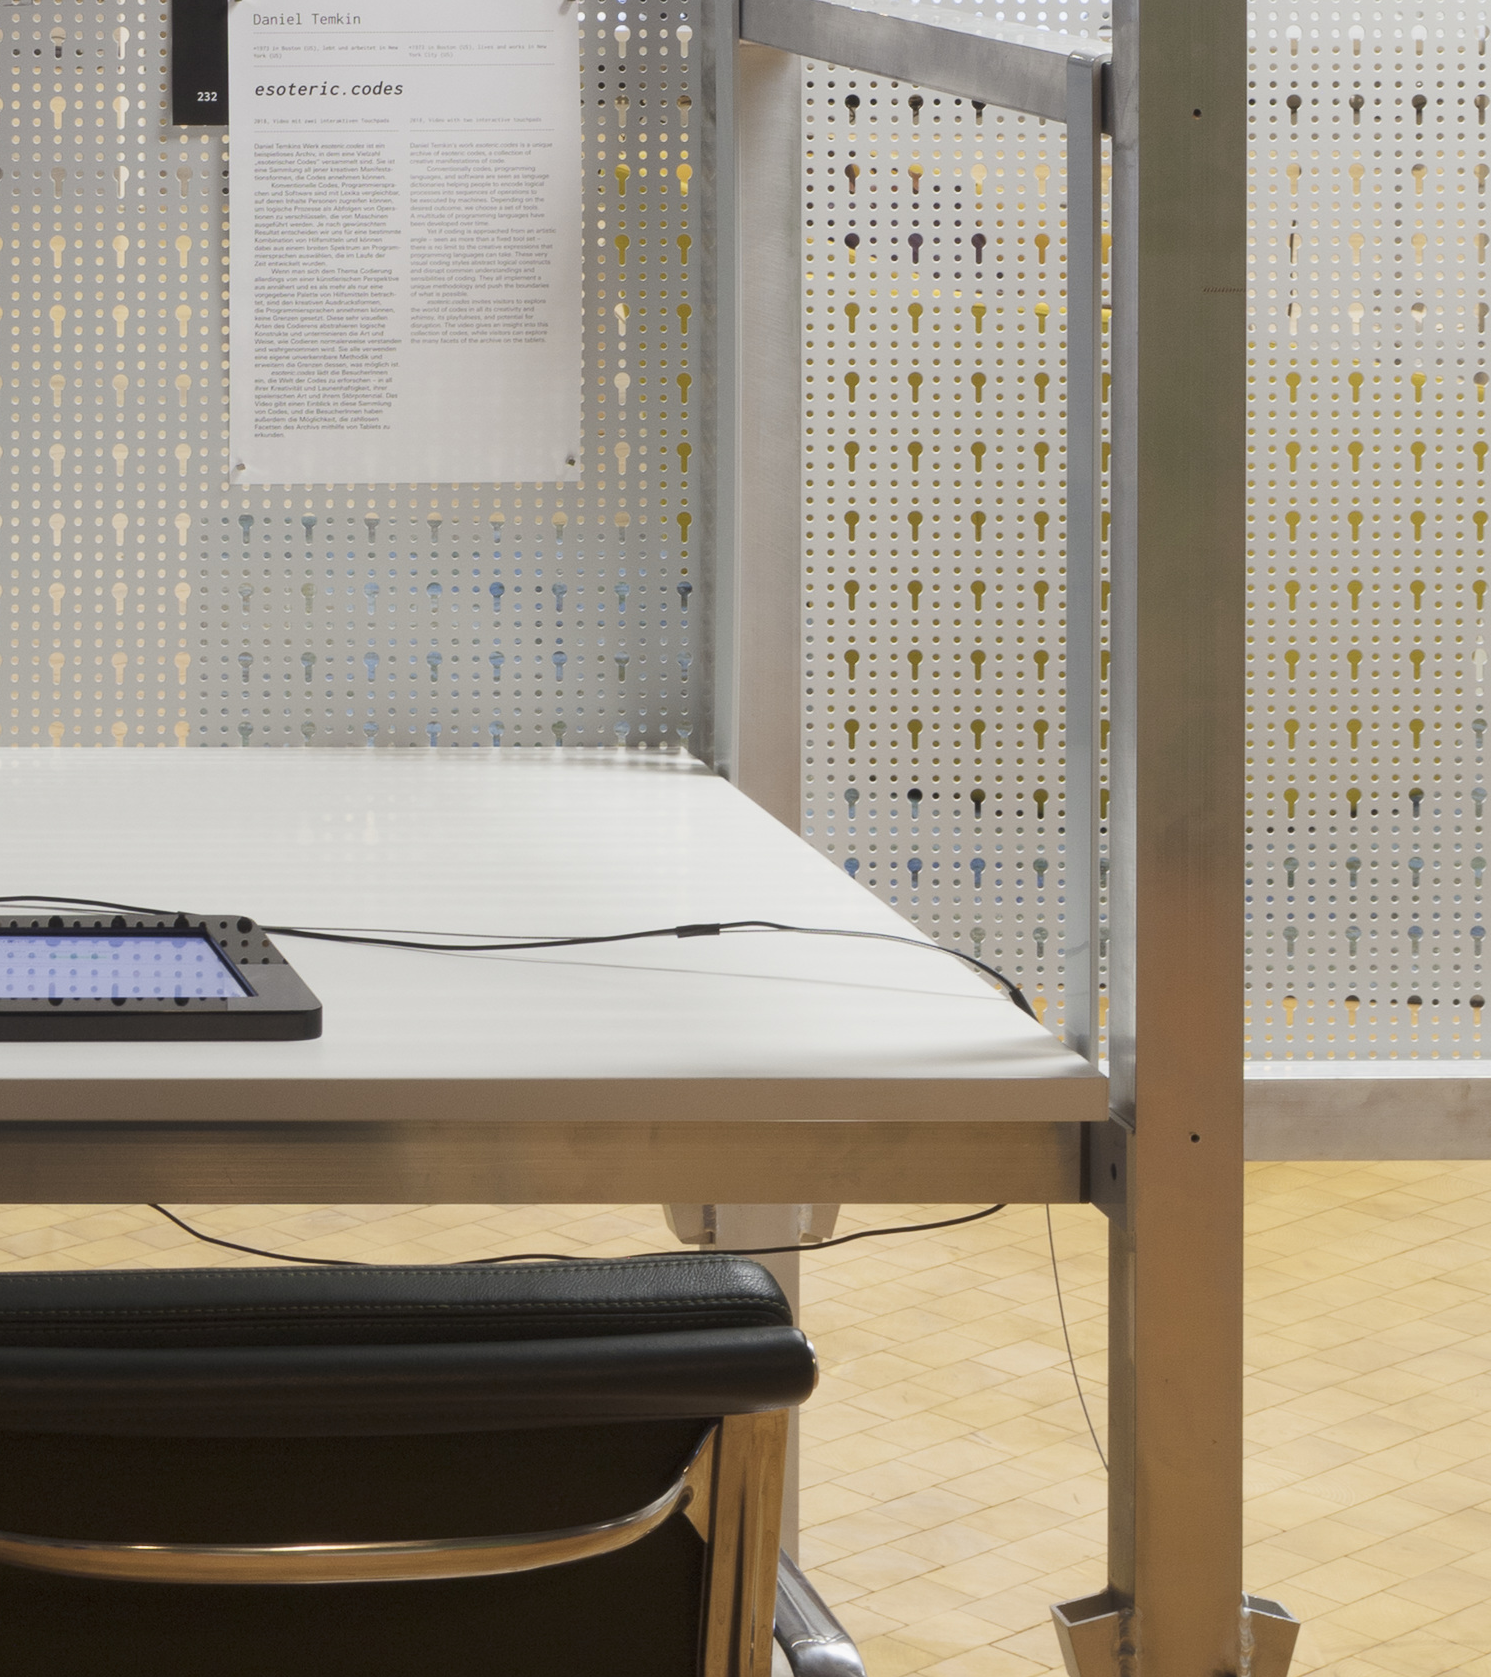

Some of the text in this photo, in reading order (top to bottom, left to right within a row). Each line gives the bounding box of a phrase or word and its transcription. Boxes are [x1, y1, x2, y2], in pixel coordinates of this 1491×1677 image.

[253, 13, 361, 25] Daniel Temkin
[255, 81, 403, 96] esoteric.codes
[197, 91, 218, 102] 232
